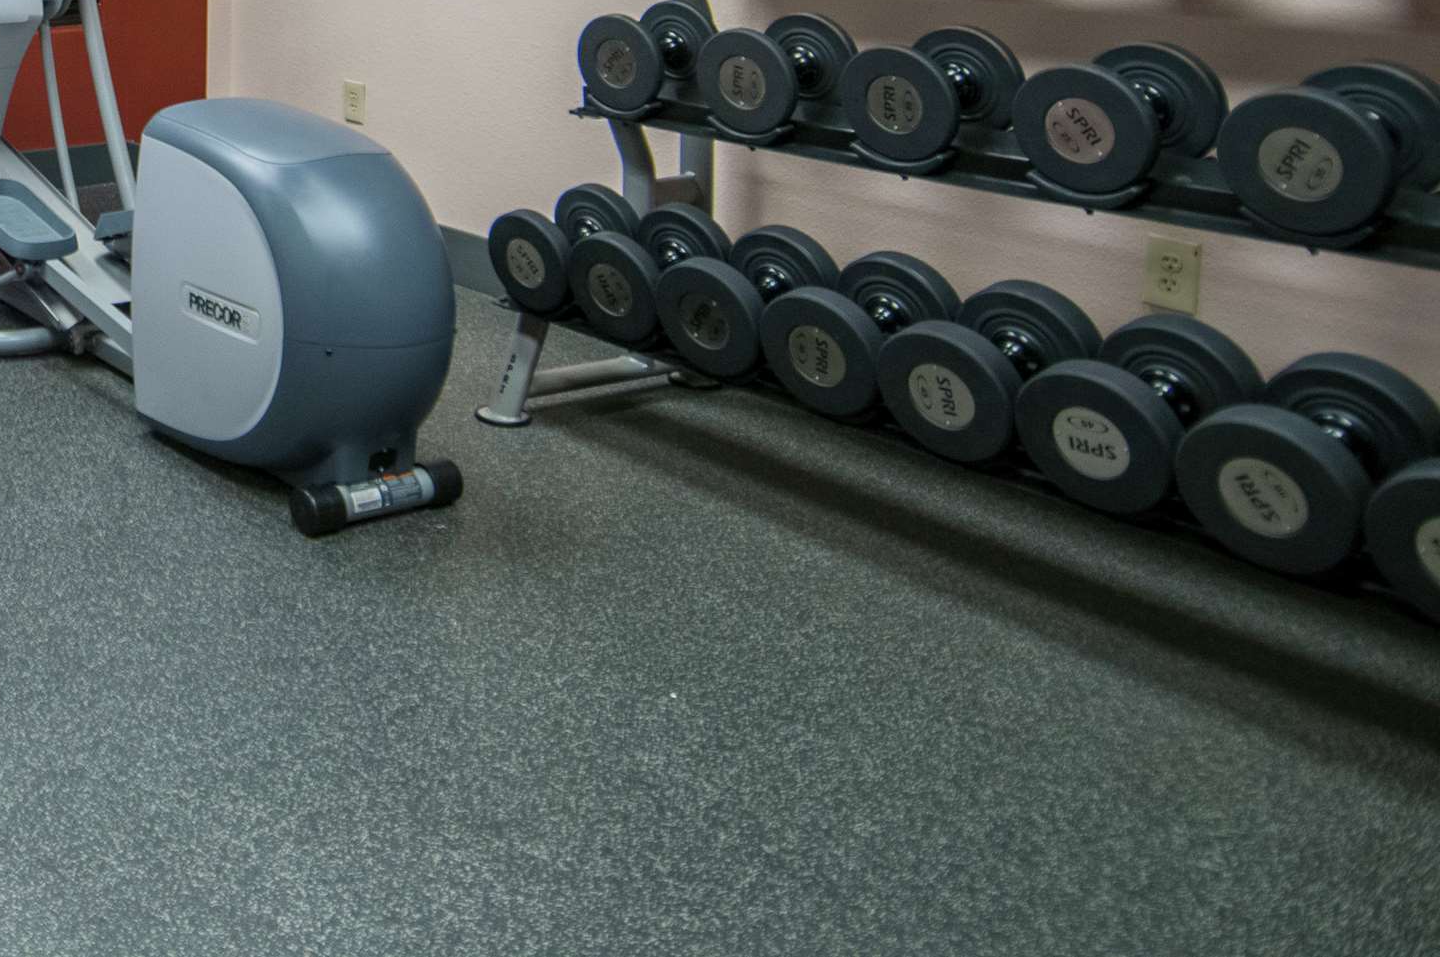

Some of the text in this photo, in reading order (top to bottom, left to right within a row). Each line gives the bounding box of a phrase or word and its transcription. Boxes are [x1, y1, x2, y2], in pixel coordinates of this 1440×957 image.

[732, 65, 745, 100] SPRI
[884, 86, 897, 122] SPRI
[1066, 107, 1102, 146] SPRI
[1276, 138, 1312, 181] SPRI
[189, 292, 242, 331] PRECOR
[816, 337, 829, 375] SPRI
[936, 375, 958, 417] SPRI
[1068, 435, 1117, 461] SPRI
[1234, 473, 1281, 522] SPRI
